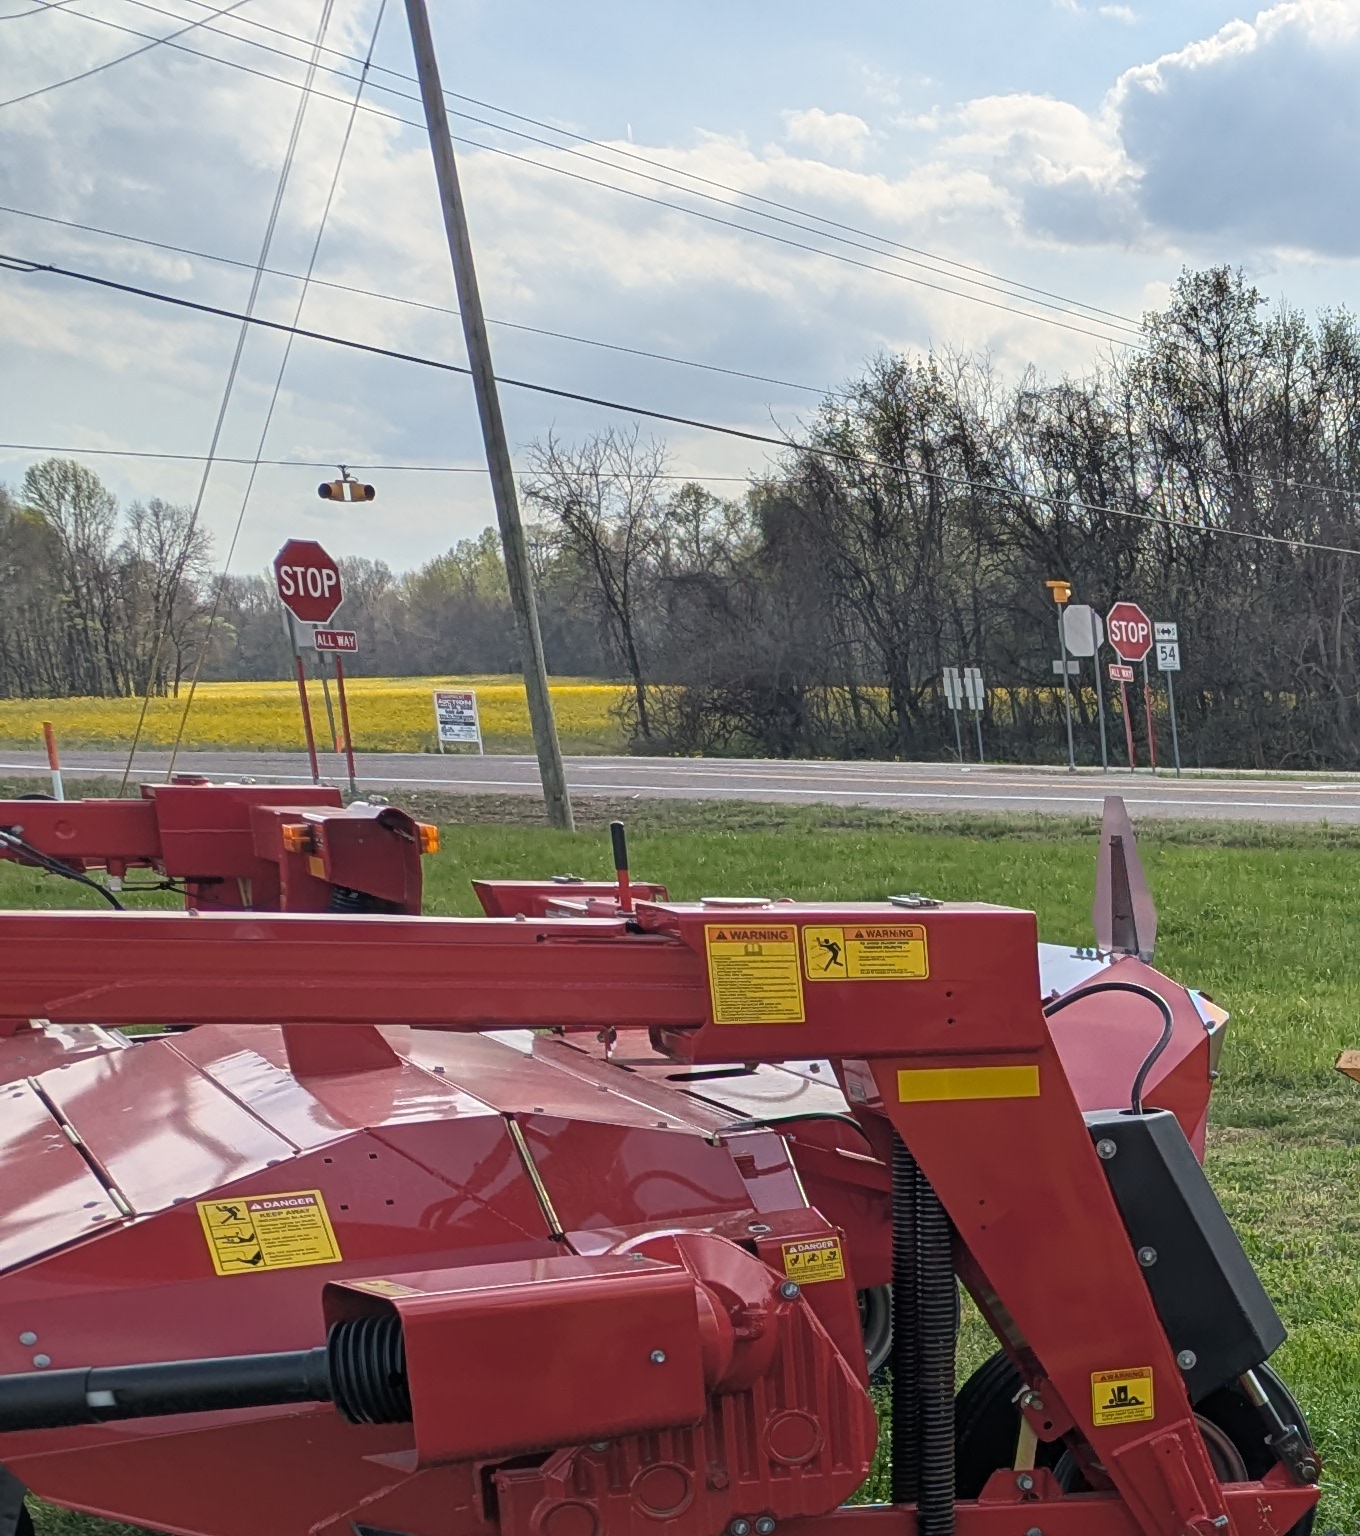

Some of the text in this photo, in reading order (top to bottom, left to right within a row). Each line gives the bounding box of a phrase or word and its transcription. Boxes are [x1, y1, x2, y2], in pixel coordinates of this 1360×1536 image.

[280, 565, 337, 598] STOP
[1111, 620, 1148, 643] STOP
[317, 634, 354, 647] ALL WAY
[1160, 645, 1176, 662] 54
[730, 930, 789, 940] WARNING
[865, 929, 914, 938] WARNING
[263, 1197, 315, 1209] DANGER
[259, 1210, 284, 1219] KEEP
